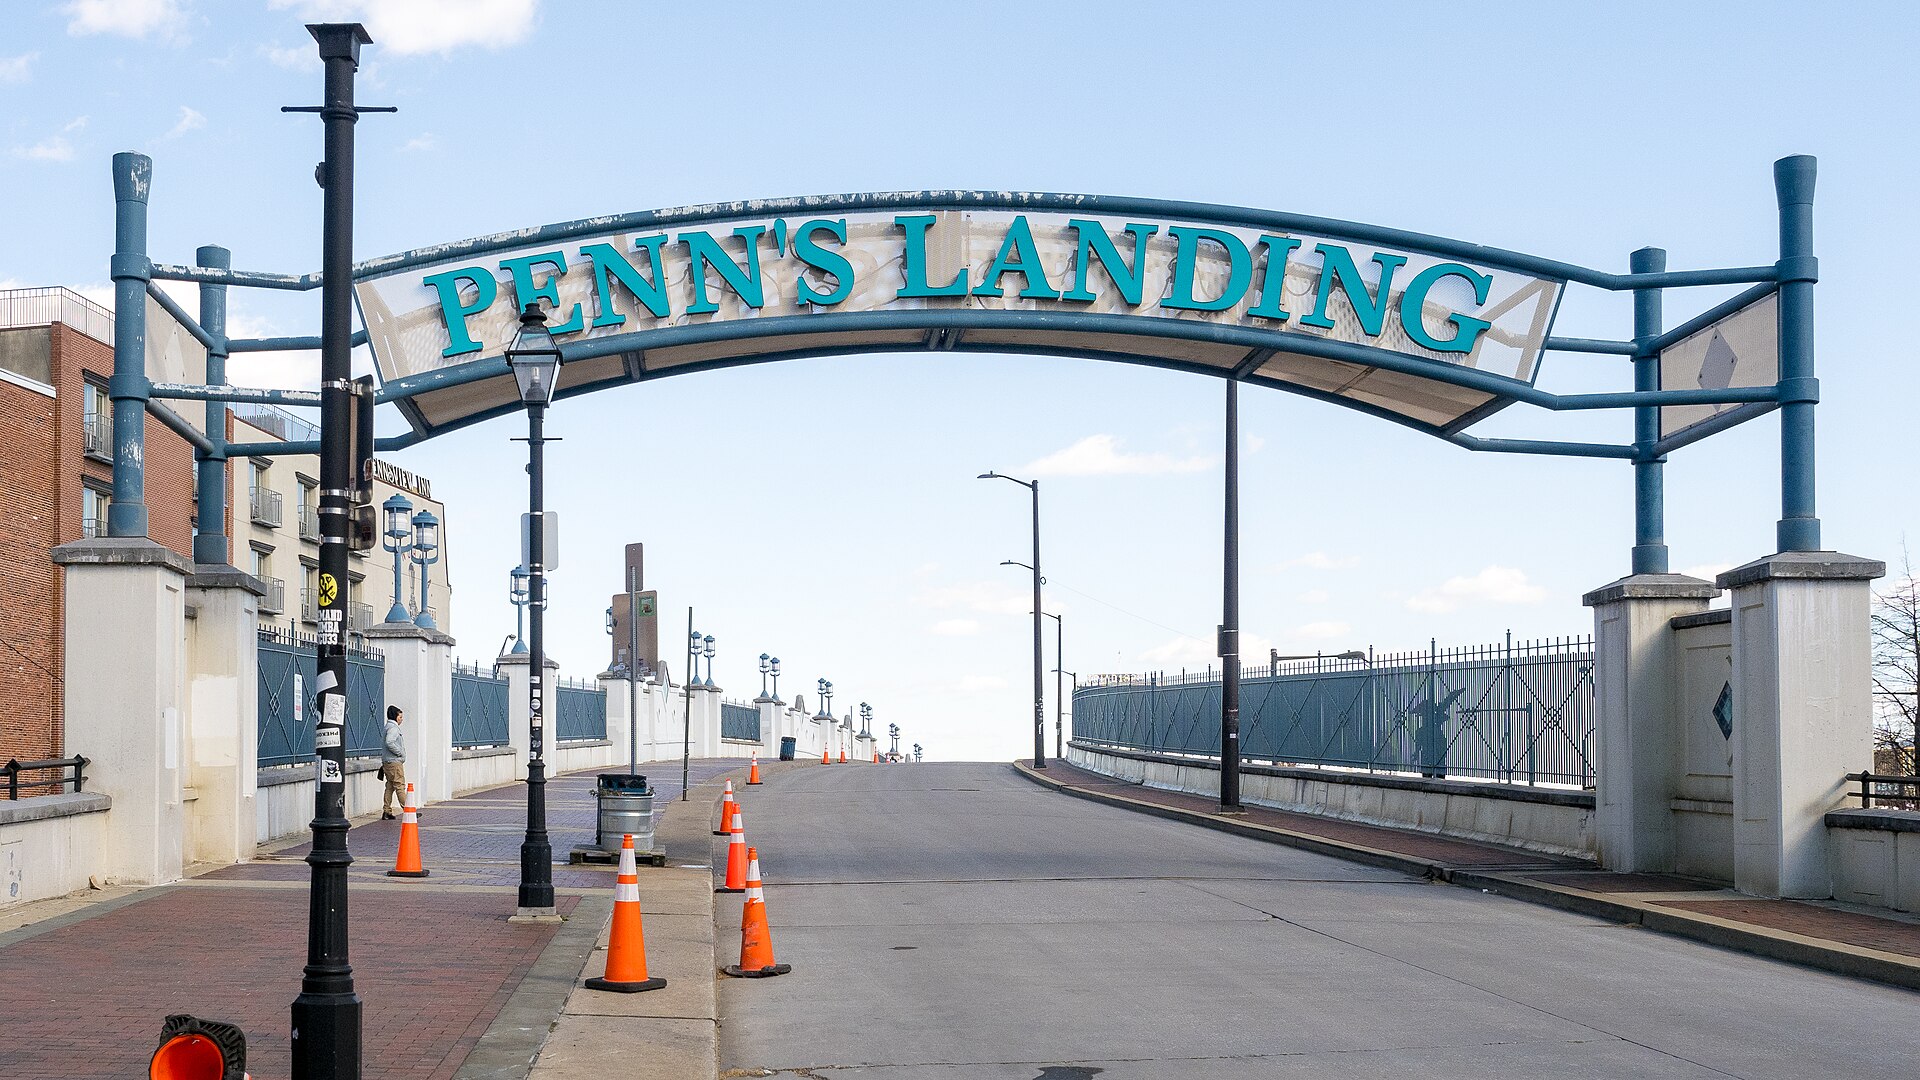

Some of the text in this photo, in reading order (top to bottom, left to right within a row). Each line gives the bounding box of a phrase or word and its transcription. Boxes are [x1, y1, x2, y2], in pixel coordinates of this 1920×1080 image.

[423, 214, 1494, 358] PENN'S LANDING
[373, 458, 432, 499] ENNSVIEW INN
